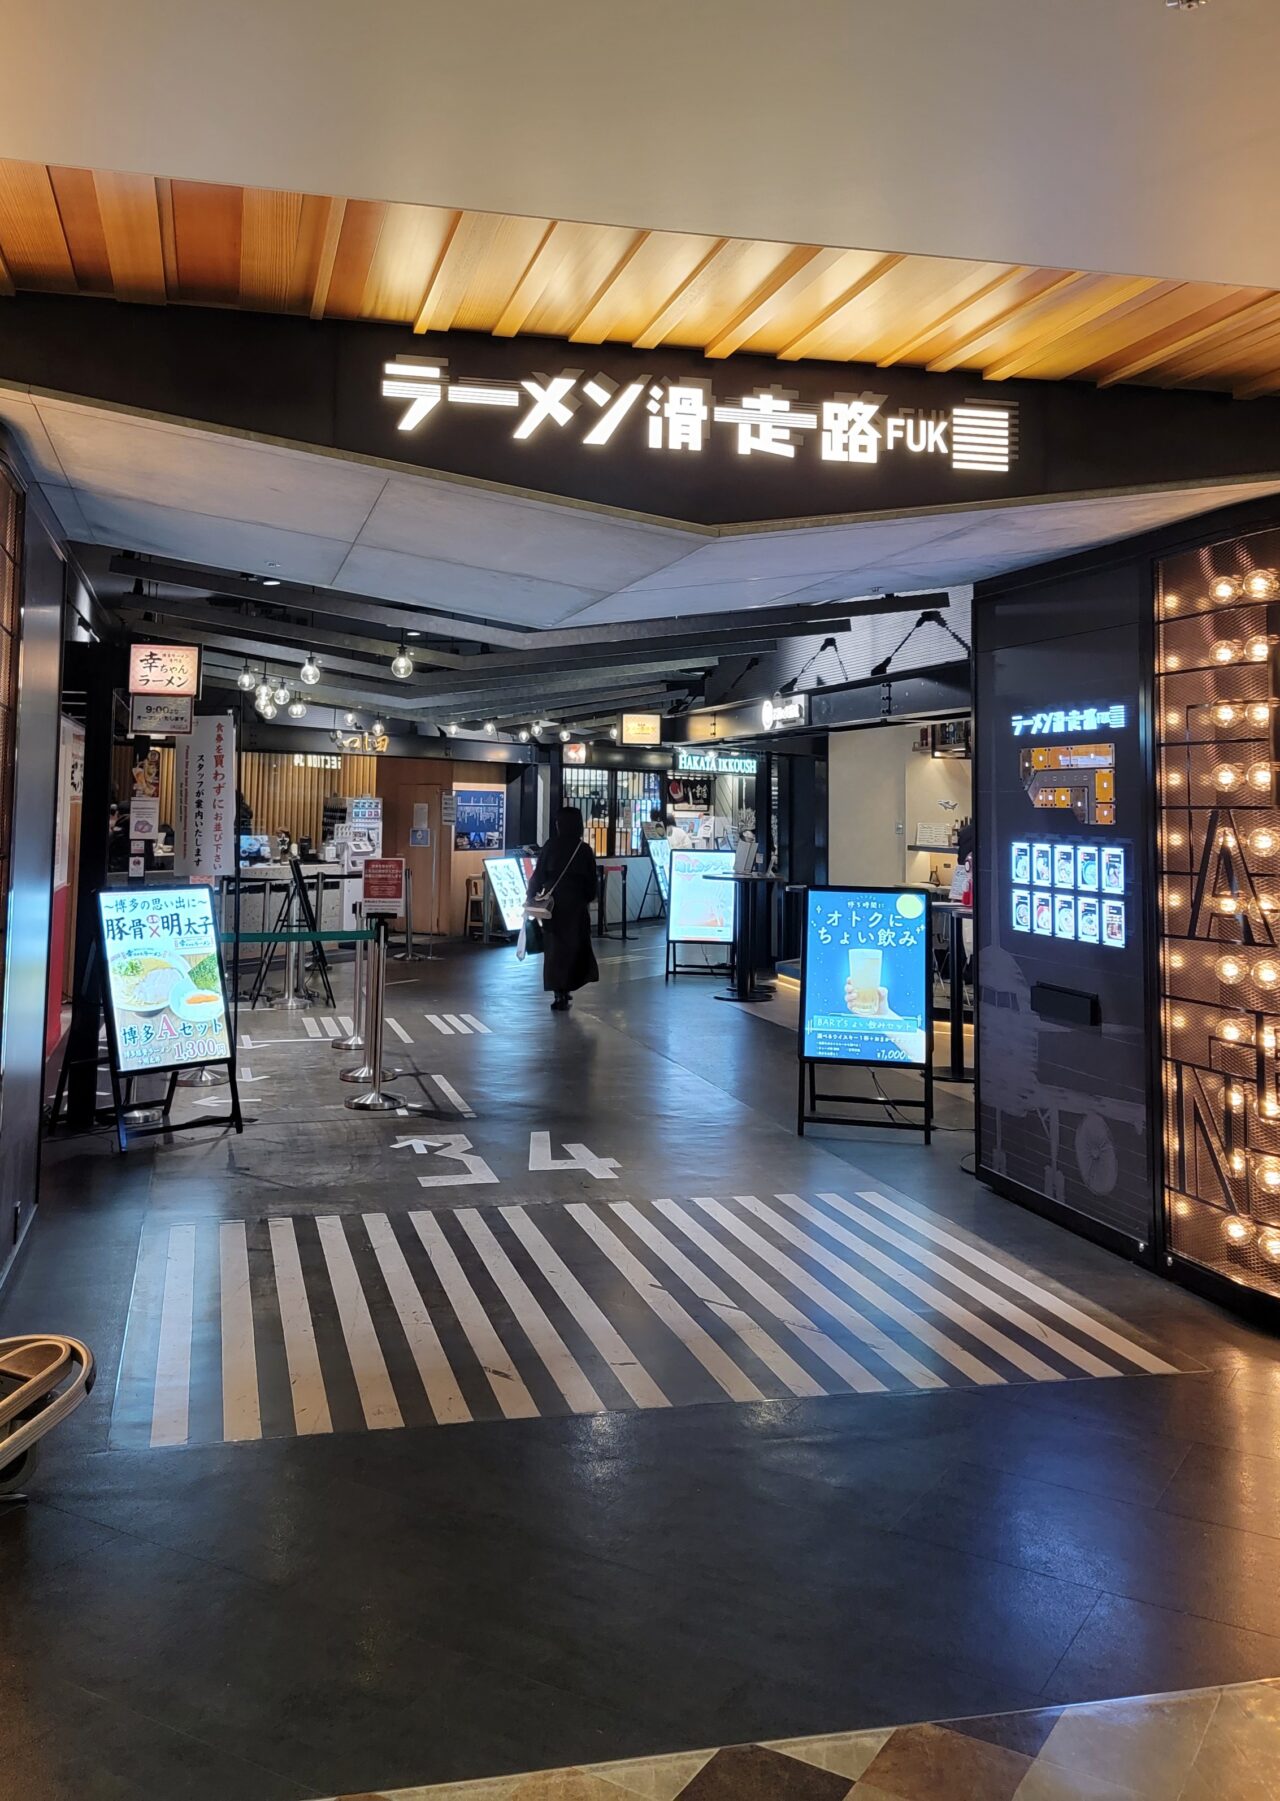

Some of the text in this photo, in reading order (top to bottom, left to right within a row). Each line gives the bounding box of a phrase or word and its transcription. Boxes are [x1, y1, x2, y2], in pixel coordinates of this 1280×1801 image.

[885, 416, 949, 454] FUK
[140, 651, 188, 674] 幸ちゃん
[138, 674, 189, 688] ラーメン
[678, 754, 717, 771] HAKATA
[826, 910, 903, 928] オトクに
[818, 926, 918, 947] ちょい飲み
[122, 1014, 222, 1044] 博多Aセット
